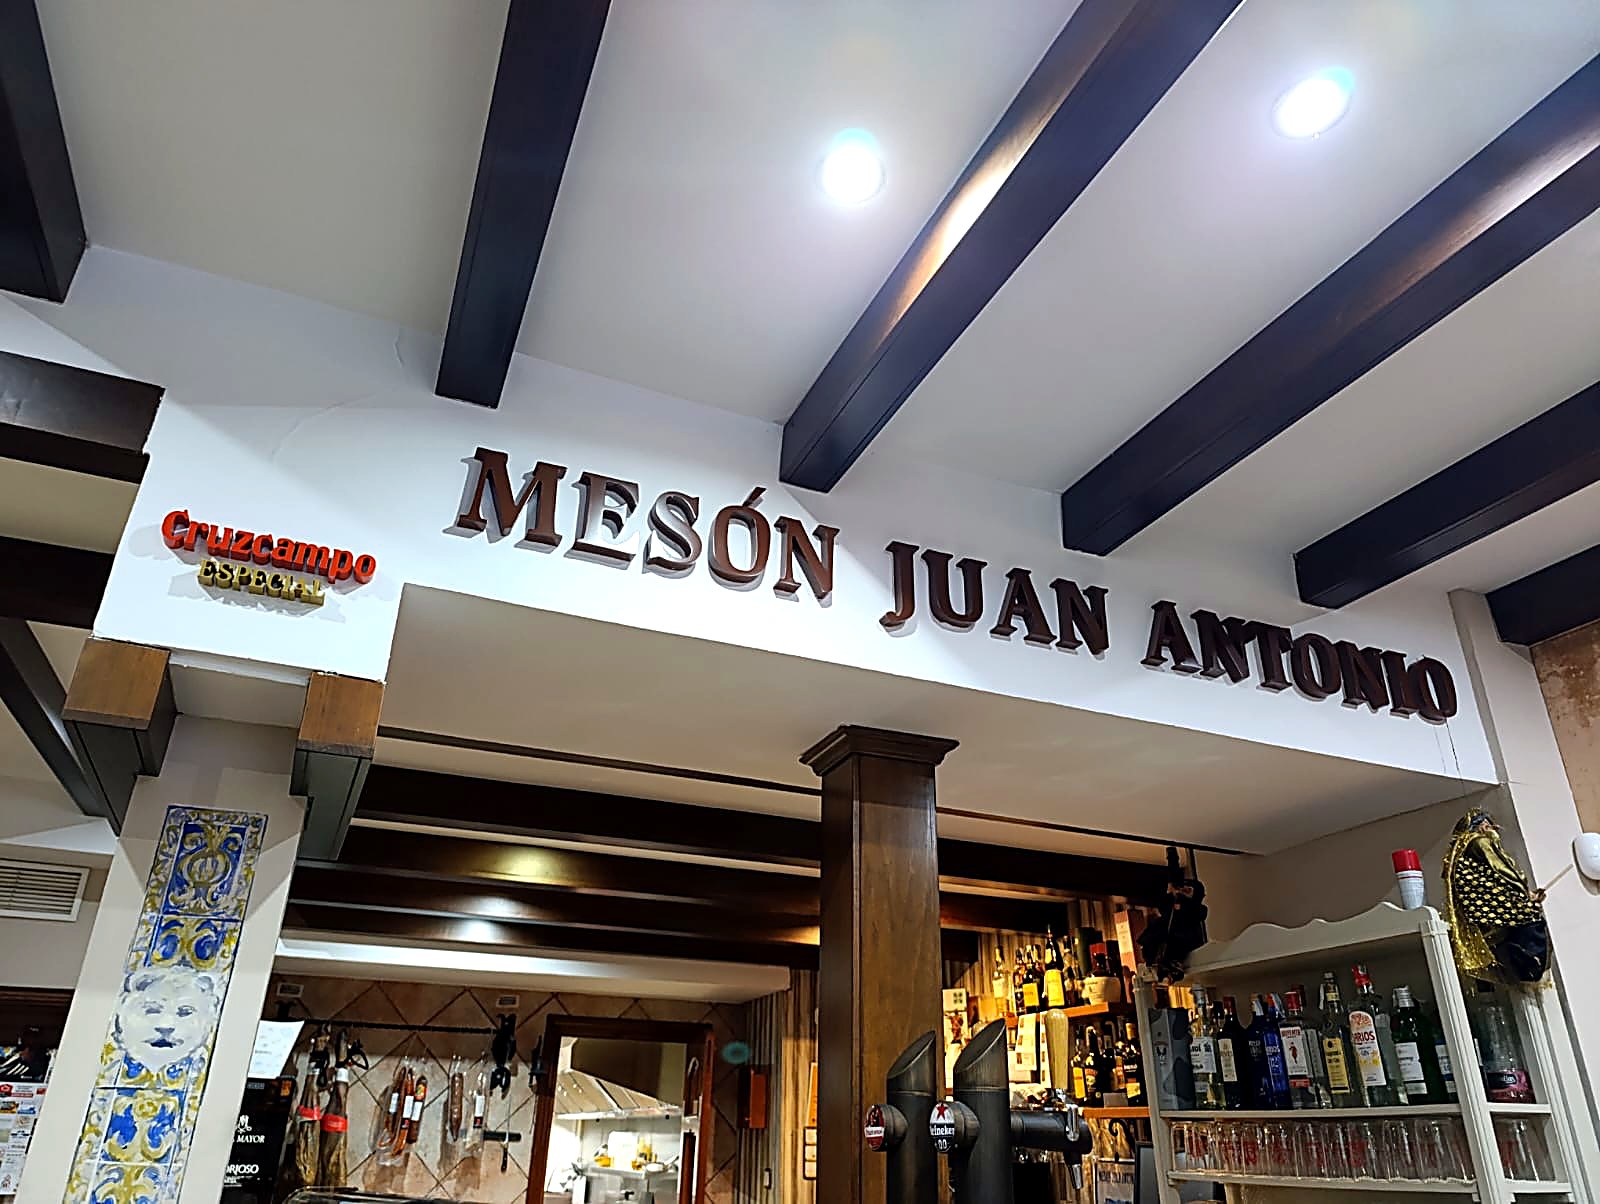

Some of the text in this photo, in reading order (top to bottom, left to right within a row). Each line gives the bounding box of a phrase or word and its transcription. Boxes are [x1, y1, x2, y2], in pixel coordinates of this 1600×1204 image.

[161, 509, 377, 584] Cruzcampo
[197, 559, 326, 606] ESPECIAL
[452, 446, 1458, 724] MESÓN JUAN ANTONIO
[237, 1135, 265, 1143] MAYOR
